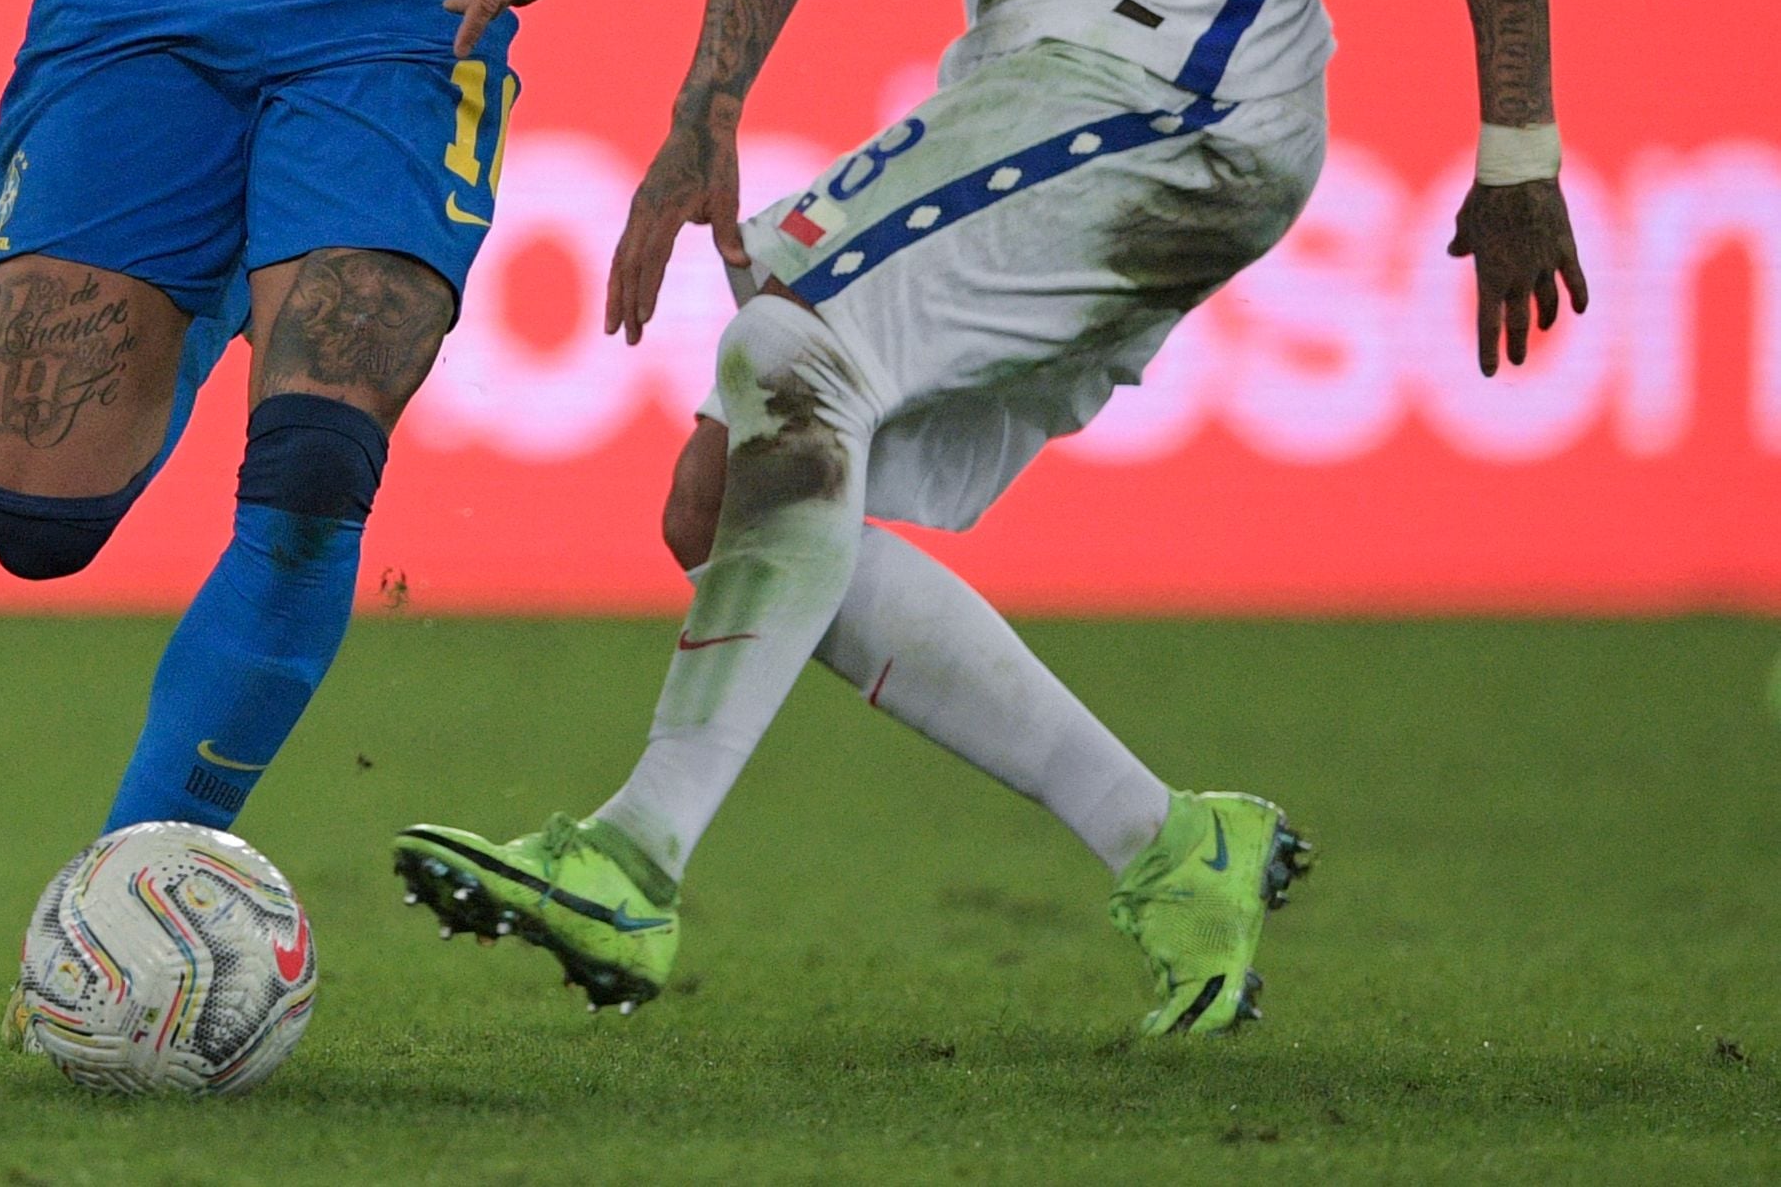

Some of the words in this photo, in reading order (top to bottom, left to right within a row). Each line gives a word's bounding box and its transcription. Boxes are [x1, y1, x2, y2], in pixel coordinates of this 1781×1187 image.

[827, 118, 926, 201] 8
[70, 272, 99, 306] de
[5, 297, 129, 354] Chance
